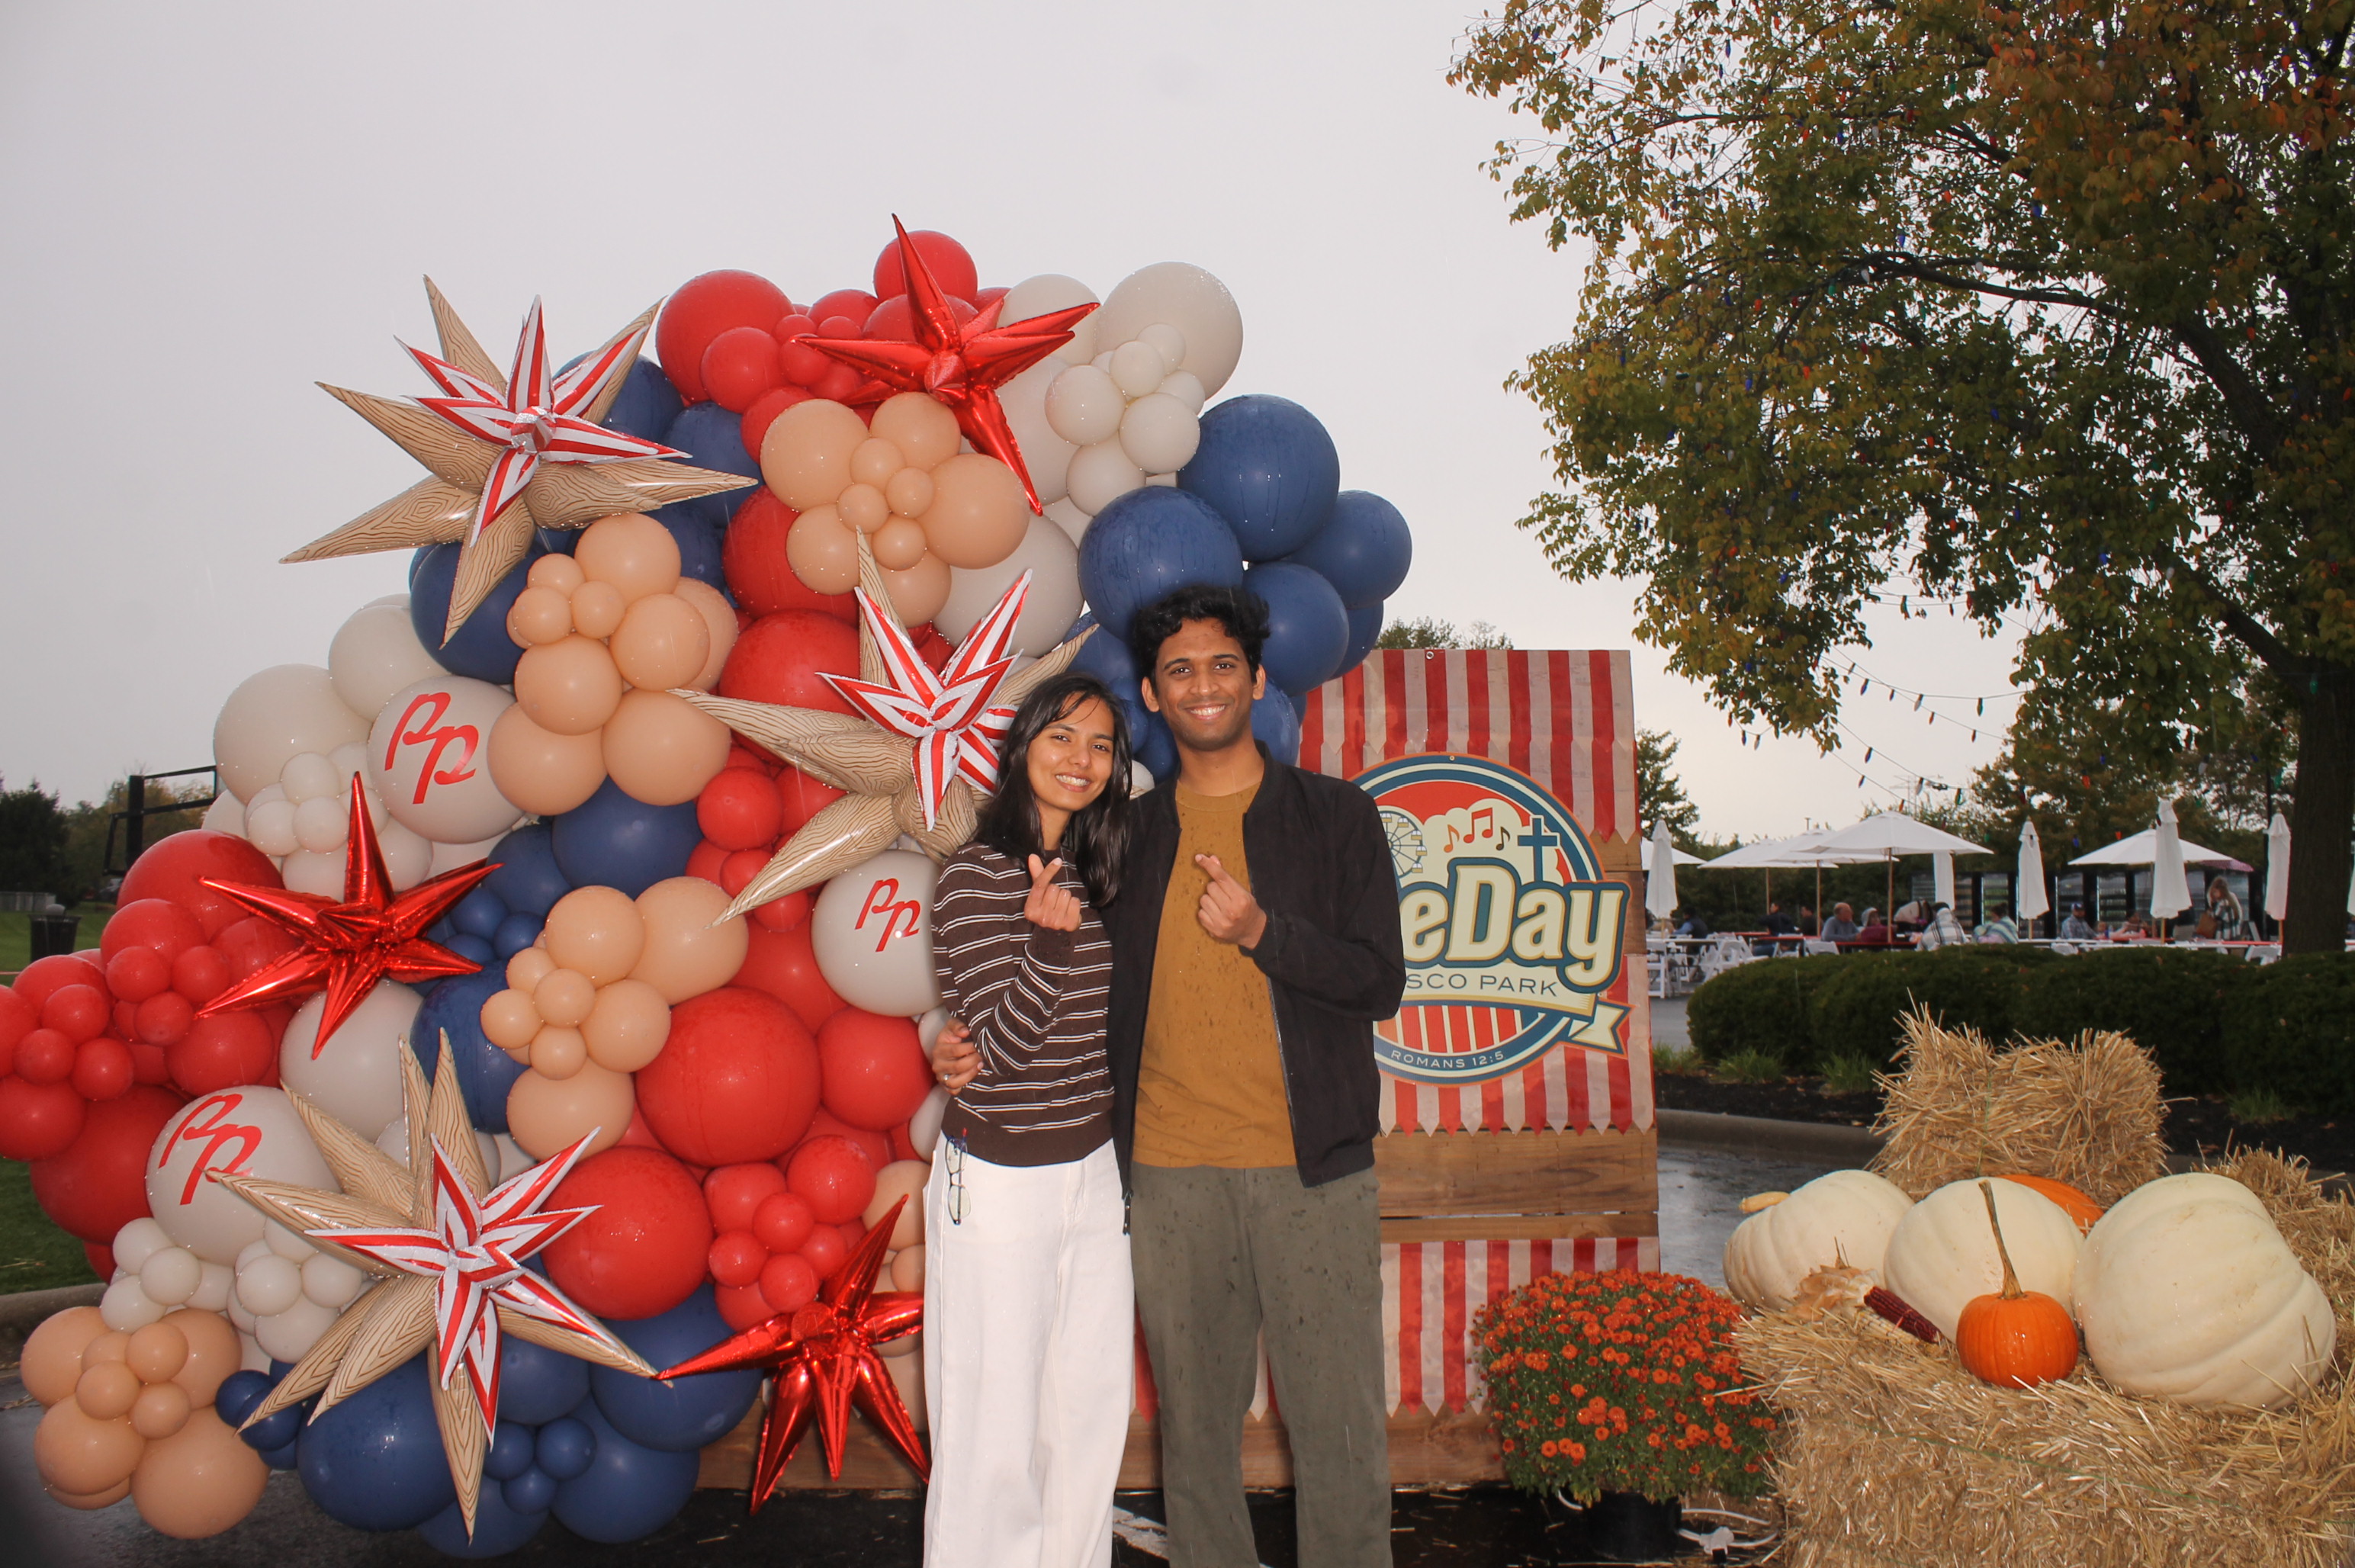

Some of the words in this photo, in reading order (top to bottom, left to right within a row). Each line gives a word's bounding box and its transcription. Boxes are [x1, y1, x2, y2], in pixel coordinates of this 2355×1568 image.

[1480, 975, 1558, 997] PARK
[1390, 1049, 1466, 1068] ROMANS
[1472, 1050, 1505, 1066] 12:5
